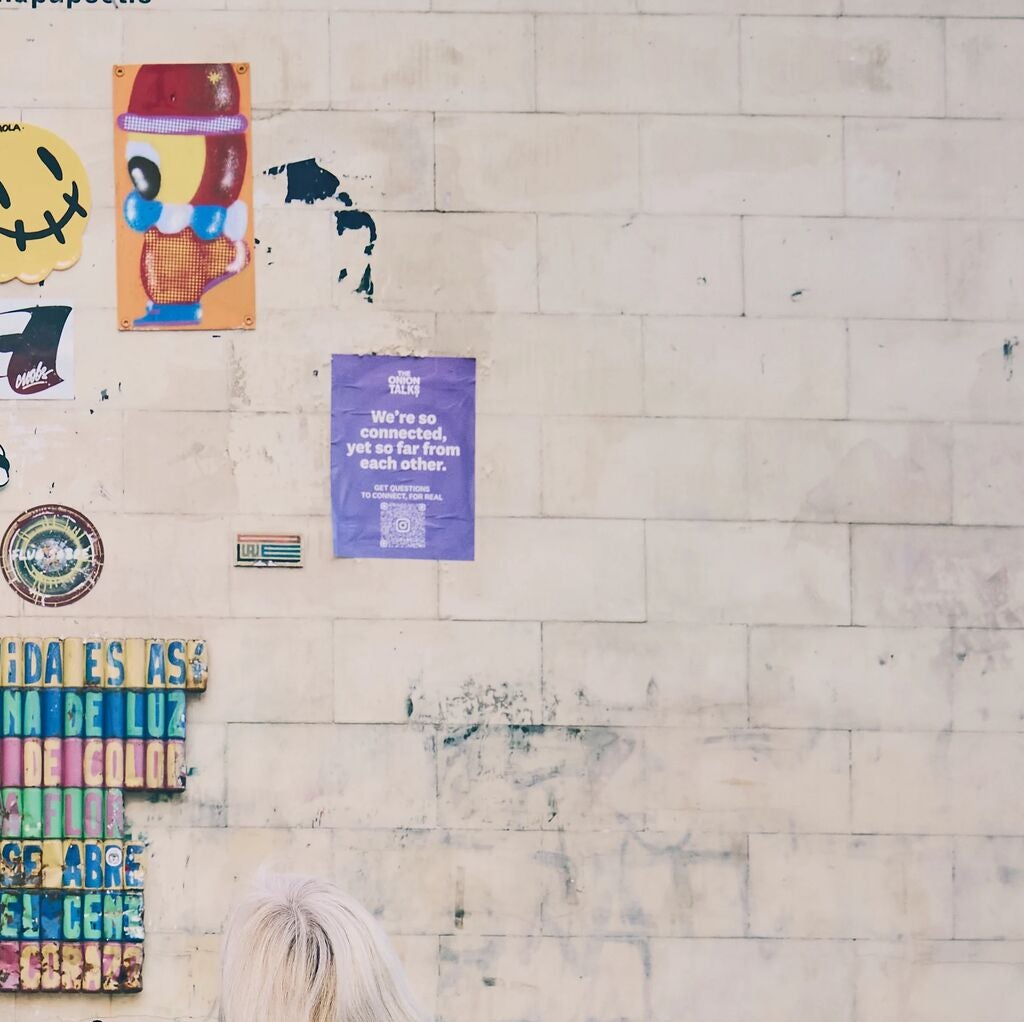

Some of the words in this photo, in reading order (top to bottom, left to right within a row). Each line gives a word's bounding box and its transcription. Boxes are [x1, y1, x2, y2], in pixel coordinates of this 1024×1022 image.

[388, 376, 420, 385] ONION
[389, 385, 420, 397] TALKS
[371, 410, 415, 424] We're
[418, 413, 437, 424] so
[360, 426, 447, 442] connected,
[346, 442, 372, 456] yet
[375, 444, 393, 454] so
[396, 441, 419, 455] far
[422, 442, 461, 456] from
[360, 456, 397, 470] each
[400, 457, 447, 471] other.
[372, 492, 408, 500] CONNECT,
[85, 642, 125, 686] ES
[64, 691, 103, 737] DE
[127, 691, 186, 737] LUZ
[23, 741, 62, 787] DE
[44, 793, 126, 837] FLOR
